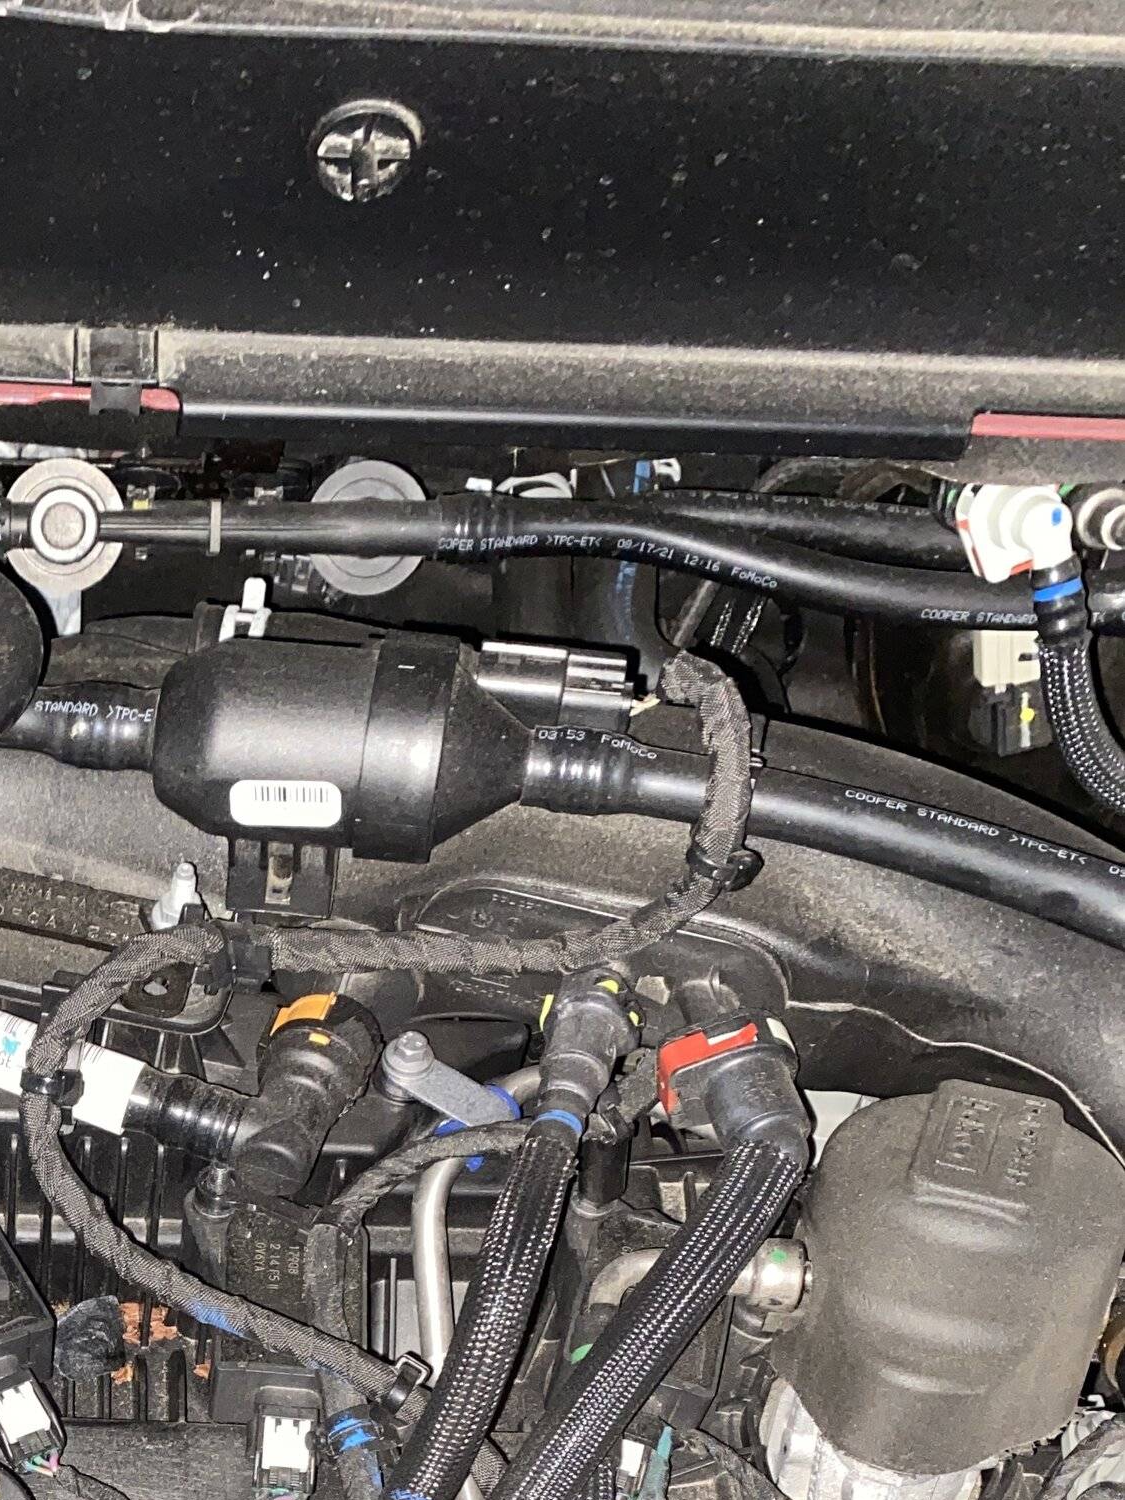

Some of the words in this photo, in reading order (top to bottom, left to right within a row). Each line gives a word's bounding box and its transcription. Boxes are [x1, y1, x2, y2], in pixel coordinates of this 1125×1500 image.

[731, 566, 778, 588] FoMoCo
[921, 608, 970, 622] COOPER
[976, 611, 1038, 624] STANDARD
[35, 700, 99, 717] STANDARD
[601, 733, 657, 760] FoMoCo
[844, 788, 908, 813] COOPER
[917, 808, 1001, 838] STANDARD
